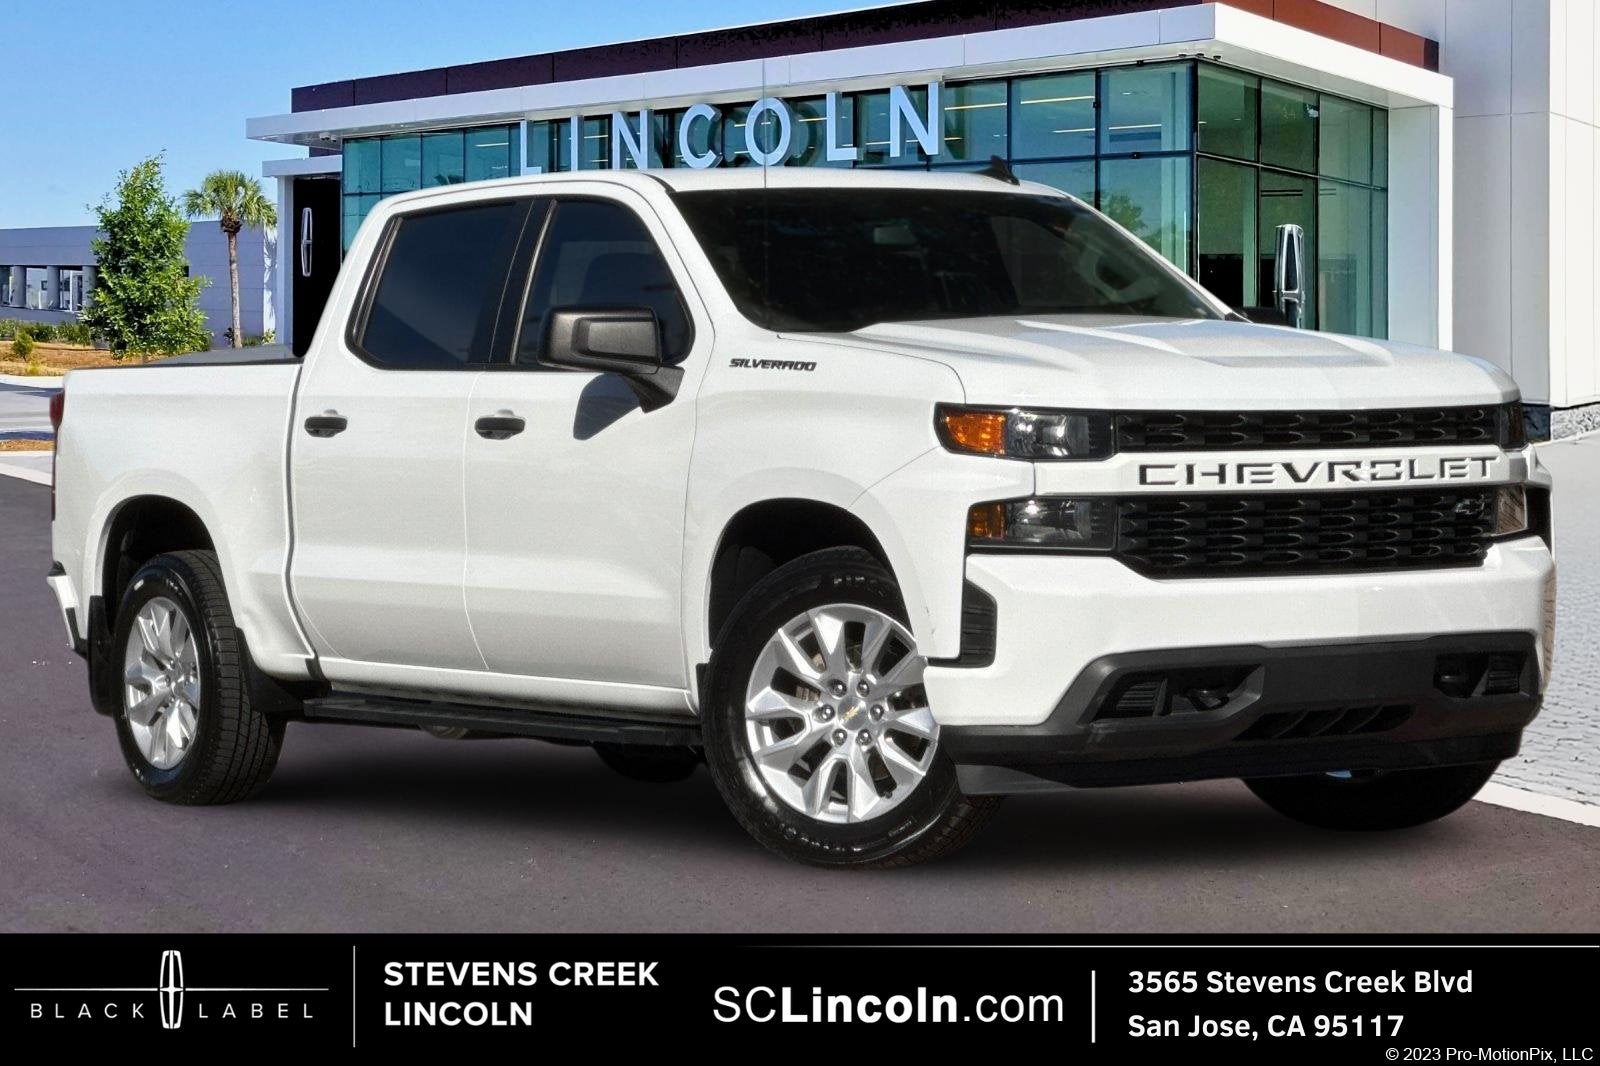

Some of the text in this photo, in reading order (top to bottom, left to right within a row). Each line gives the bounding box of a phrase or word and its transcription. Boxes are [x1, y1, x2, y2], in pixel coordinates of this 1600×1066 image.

[520, 81, 940, 174] LINCOLN
[729, 358, 817, 371] SILVERADO
[1138, 456, 1500, 486] CHEVROLET
